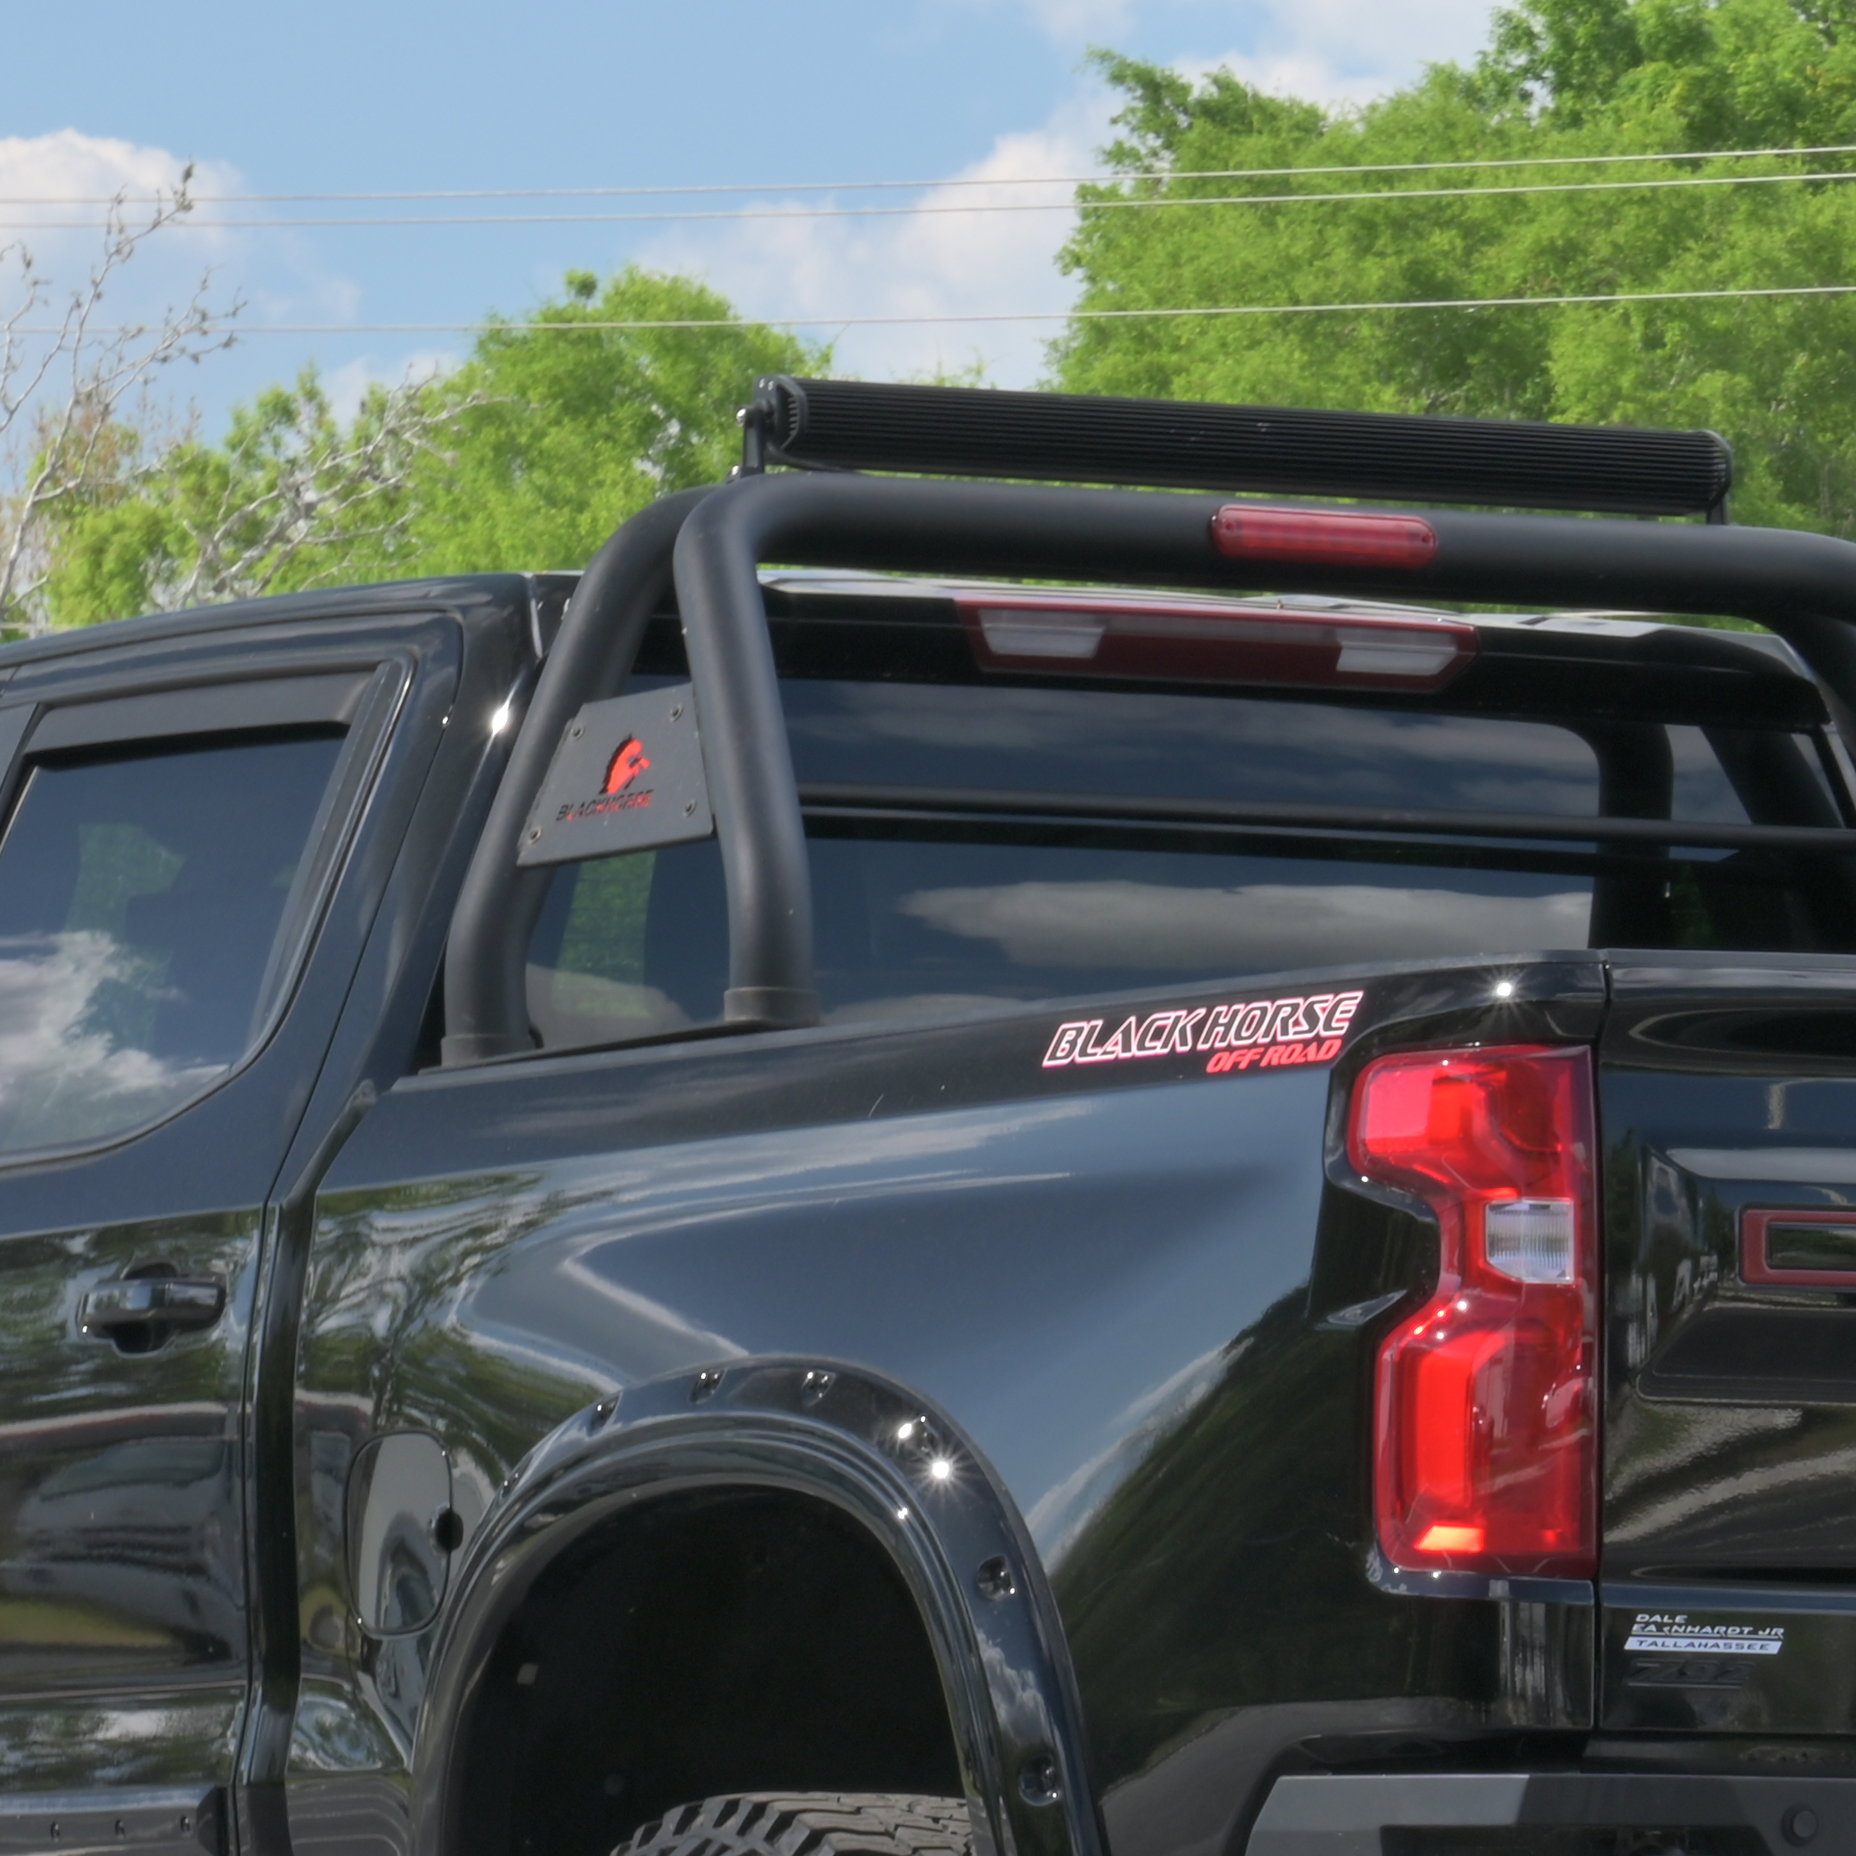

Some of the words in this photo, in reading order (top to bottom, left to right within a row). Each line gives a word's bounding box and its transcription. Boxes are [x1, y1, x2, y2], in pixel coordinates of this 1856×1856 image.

[1042, 1008, 1207, 1068] BLACK
[1197, 990, 1364, 1051] HORSE
[1206, 1047, 1263, 1074] OFF
[1259, 1039, 1343, 1069] ROAD
[1635, 1613, 1689, 1624] DALE
[1758, 1627, 1784, 1639] JR
[1636, 1639, 1770, 1651] TALLAHASSEE
